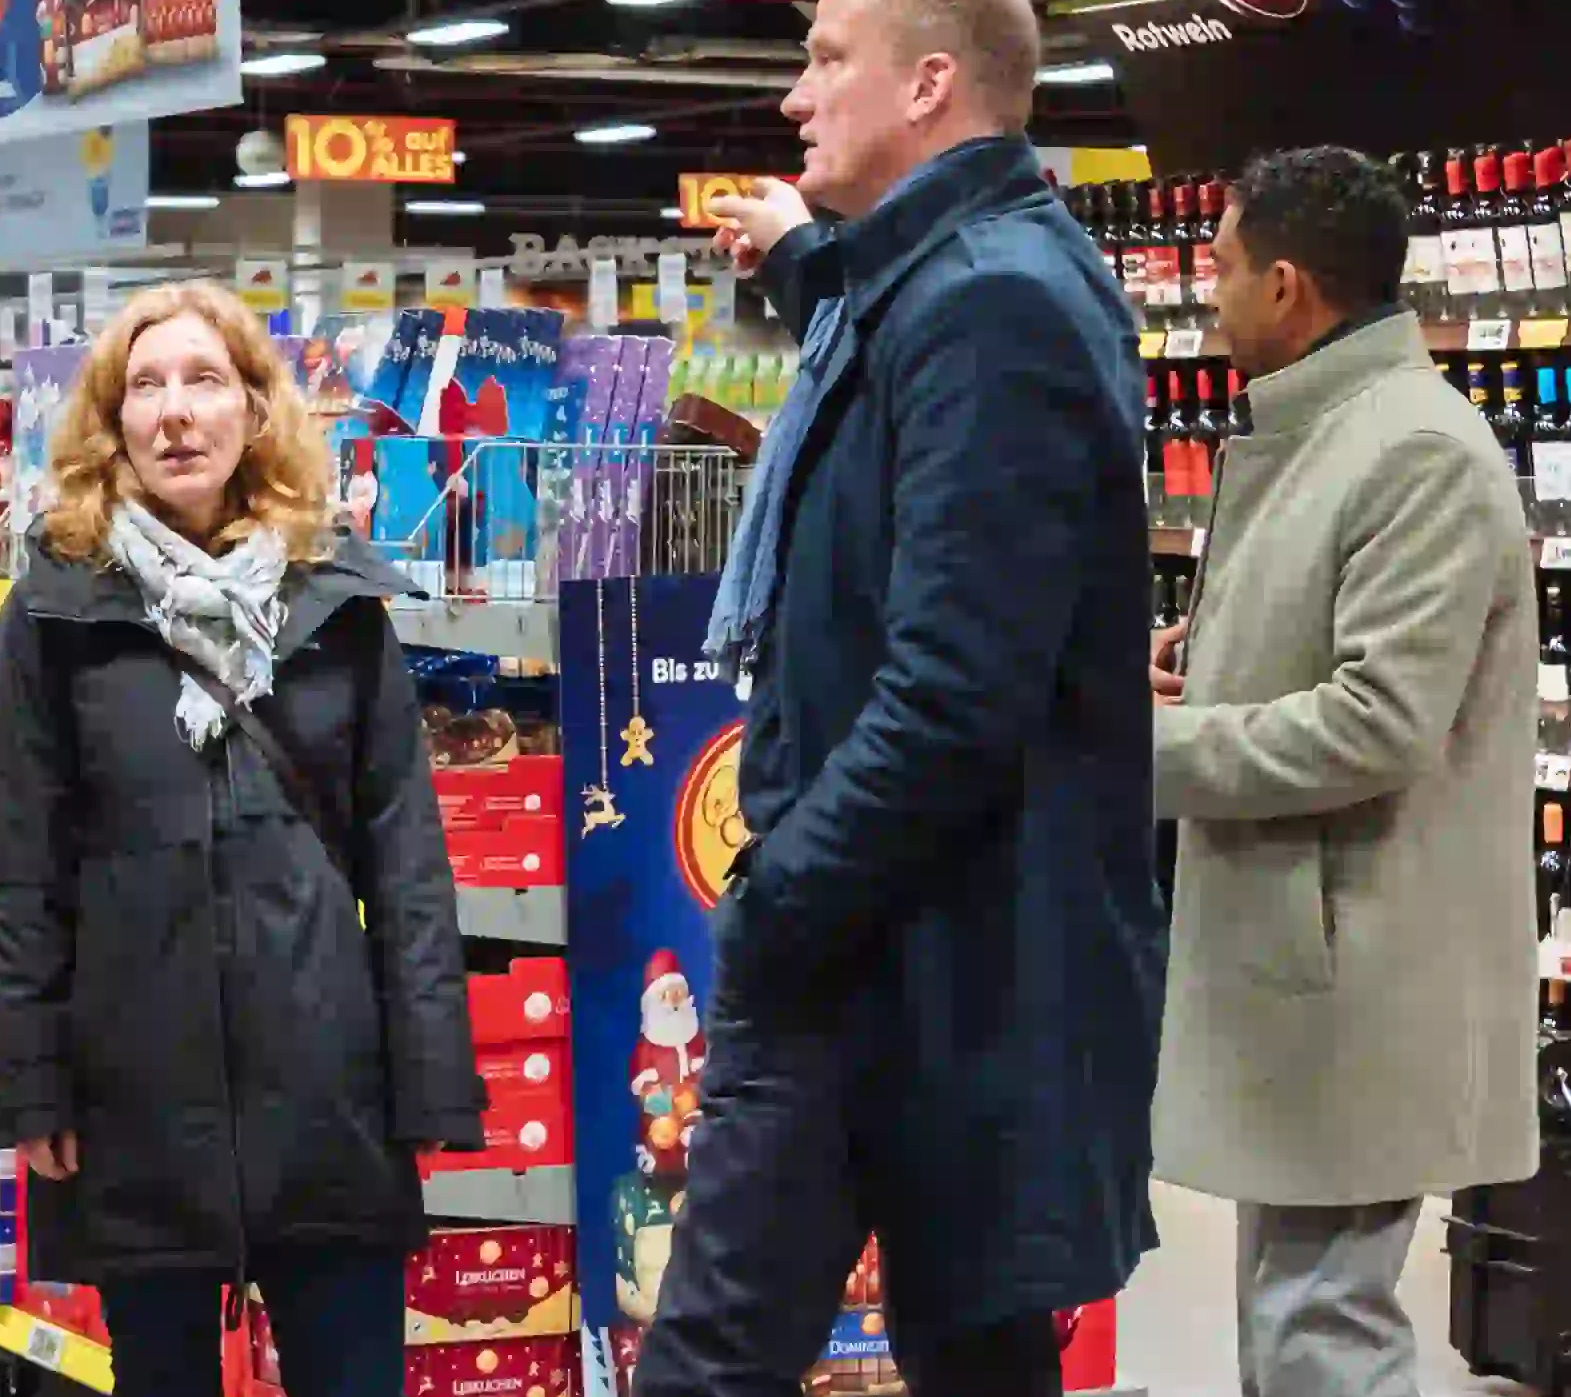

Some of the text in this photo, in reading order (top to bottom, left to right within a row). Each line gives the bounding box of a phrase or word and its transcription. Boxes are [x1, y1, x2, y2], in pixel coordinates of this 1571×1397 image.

[1111, 12, 1233, 52] Rotwein
[405, 126, 450, 151] auf
[371, 152, 451, 179] ALLES
